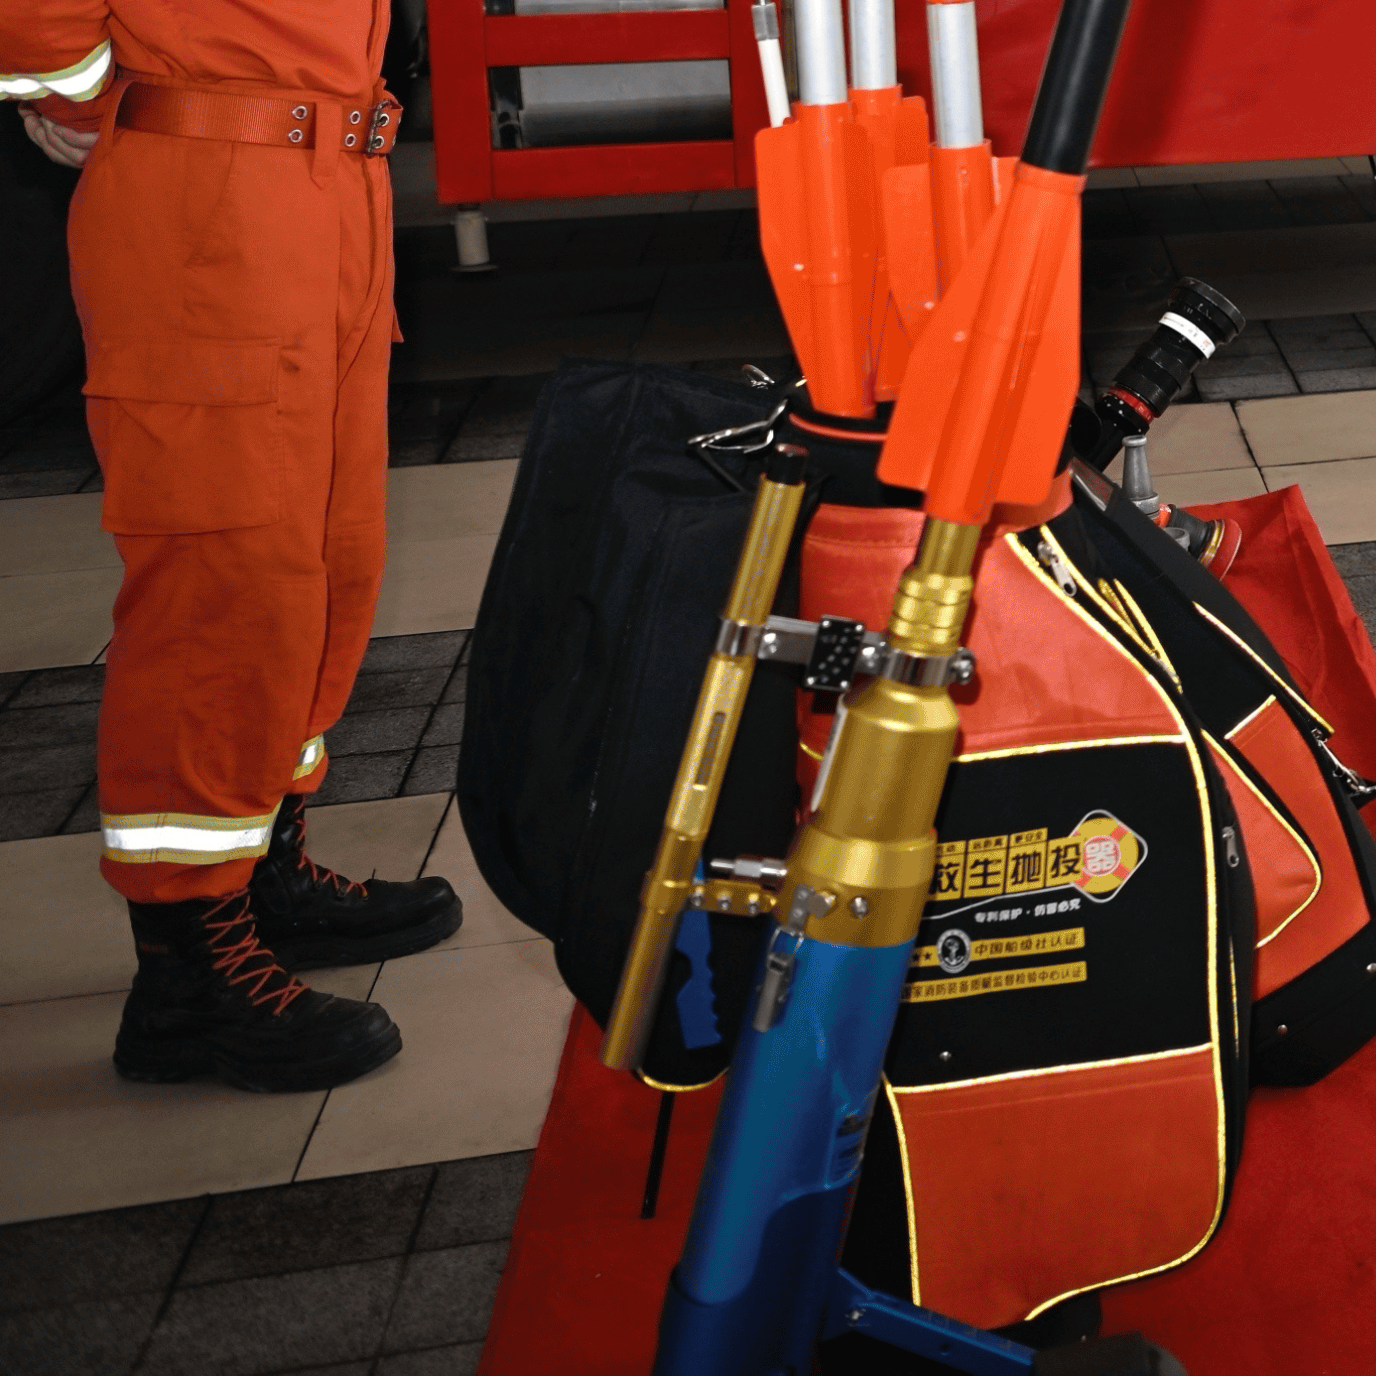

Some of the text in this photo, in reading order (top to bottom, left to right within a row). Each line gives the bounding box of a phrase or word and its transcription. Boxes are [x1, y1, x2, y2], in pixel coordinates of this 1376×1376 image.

[974, 932, 1077, 957] 中国船级社认证
